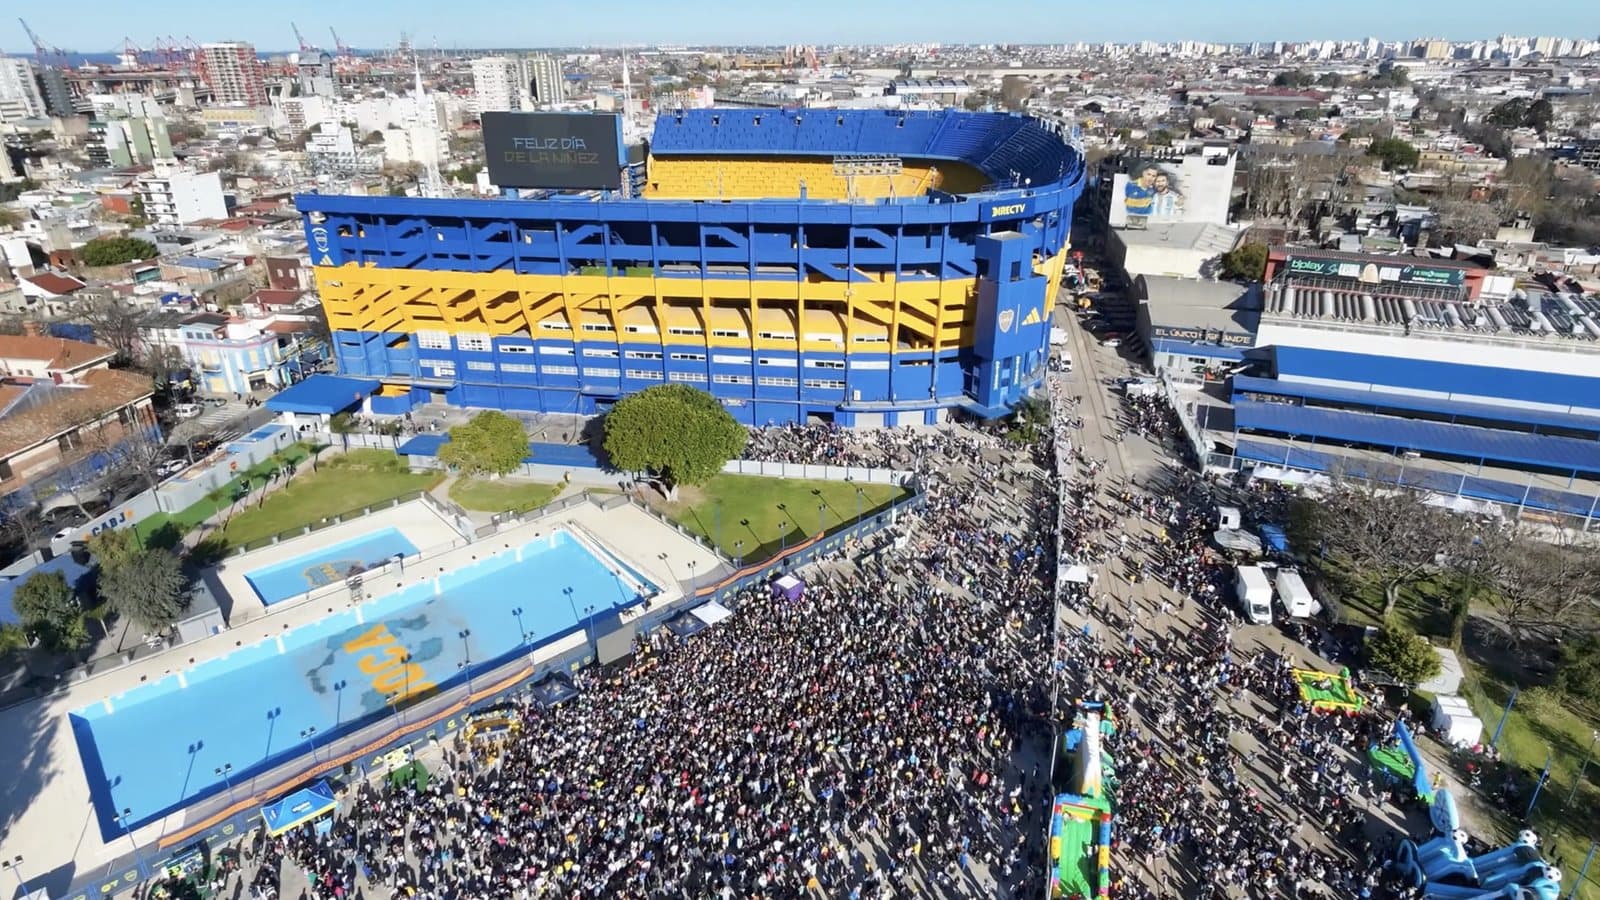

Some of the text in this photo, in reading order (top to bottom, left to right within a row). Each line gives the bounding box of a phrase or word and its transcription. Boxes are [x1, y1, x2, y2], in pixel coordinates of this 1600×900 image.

[512, 135, 587, 150] FELIZ DÍA
[504, 151, 526, 163] DE
[529, 151, 550, 163] LA
[991, 203, 1026, 218] DIRECTV
[1155, 328, 1169, 337] EL
[91, 511, 126, 537] CABJ
